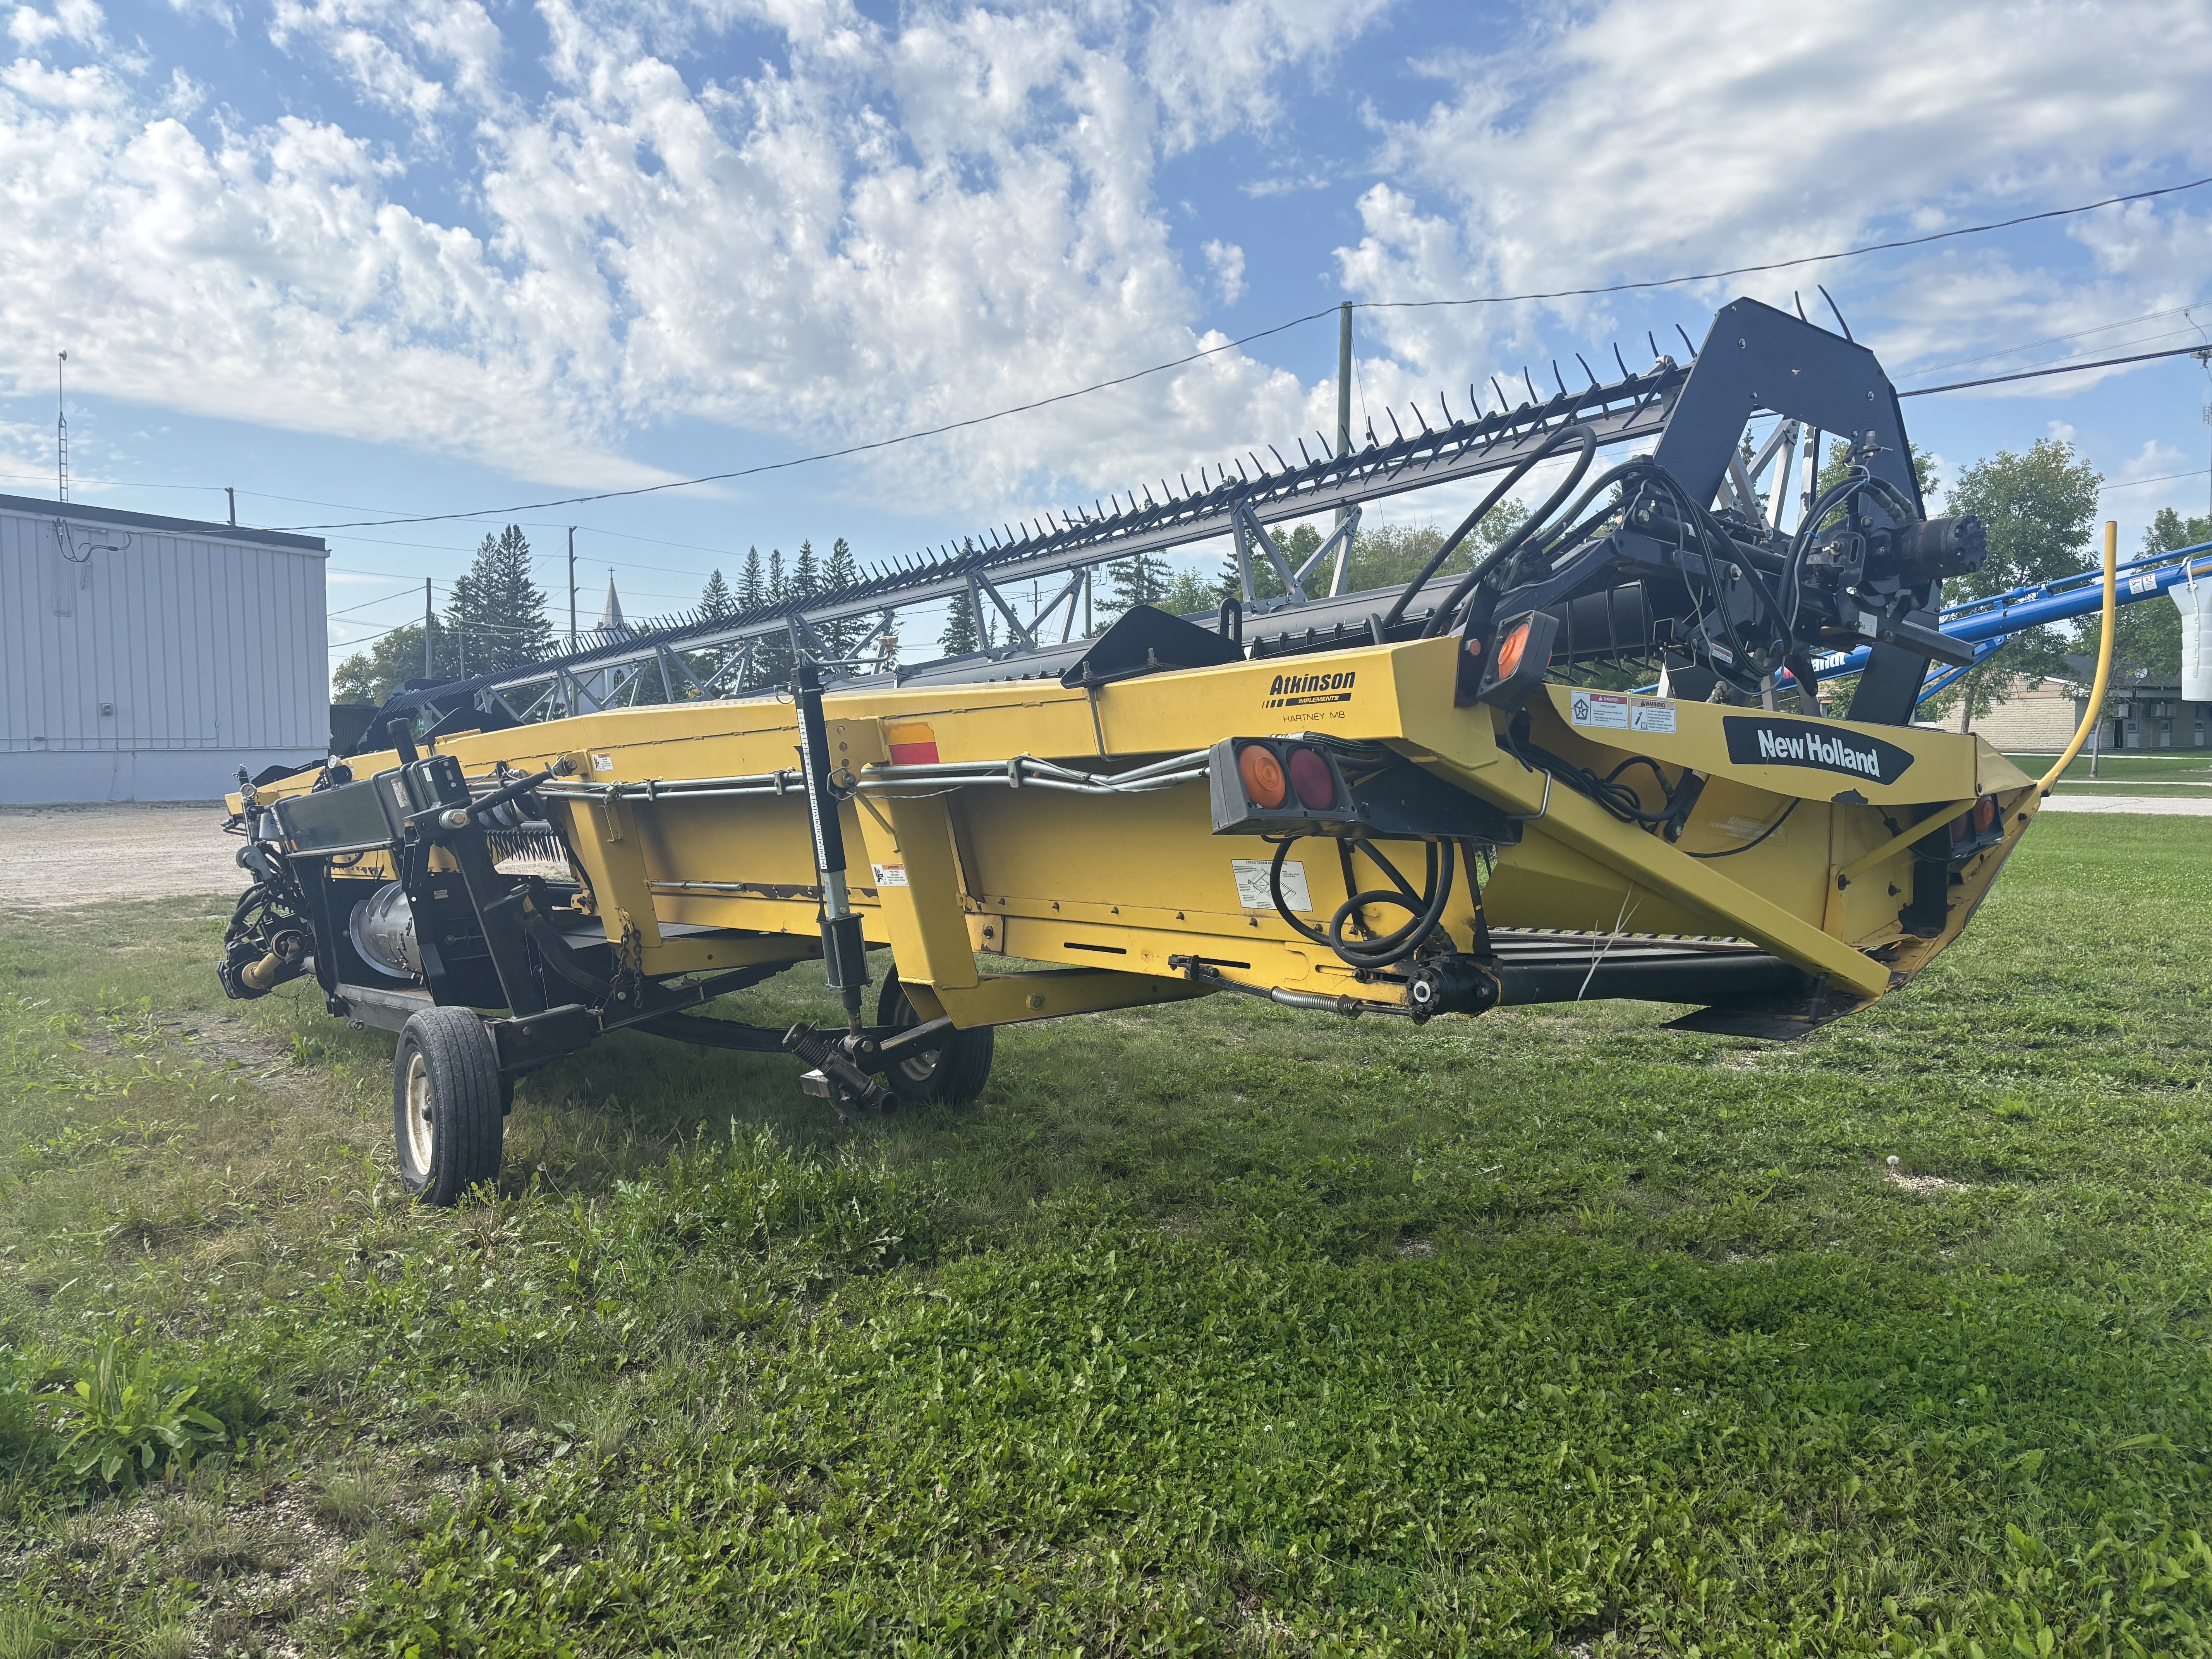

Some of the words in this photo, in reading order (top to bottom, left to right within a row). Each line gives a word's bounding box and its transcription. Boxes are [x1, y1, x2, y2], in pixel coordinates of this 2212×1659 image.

[1811, 652, 1845, 672] andt
[1270, 672, 1356, 695] Atkinson
[1283, 713, 1325, 723] HARTNEY
[1757, 730, 1803, 759] New
[1805, 733, 1880, 778] Holland
